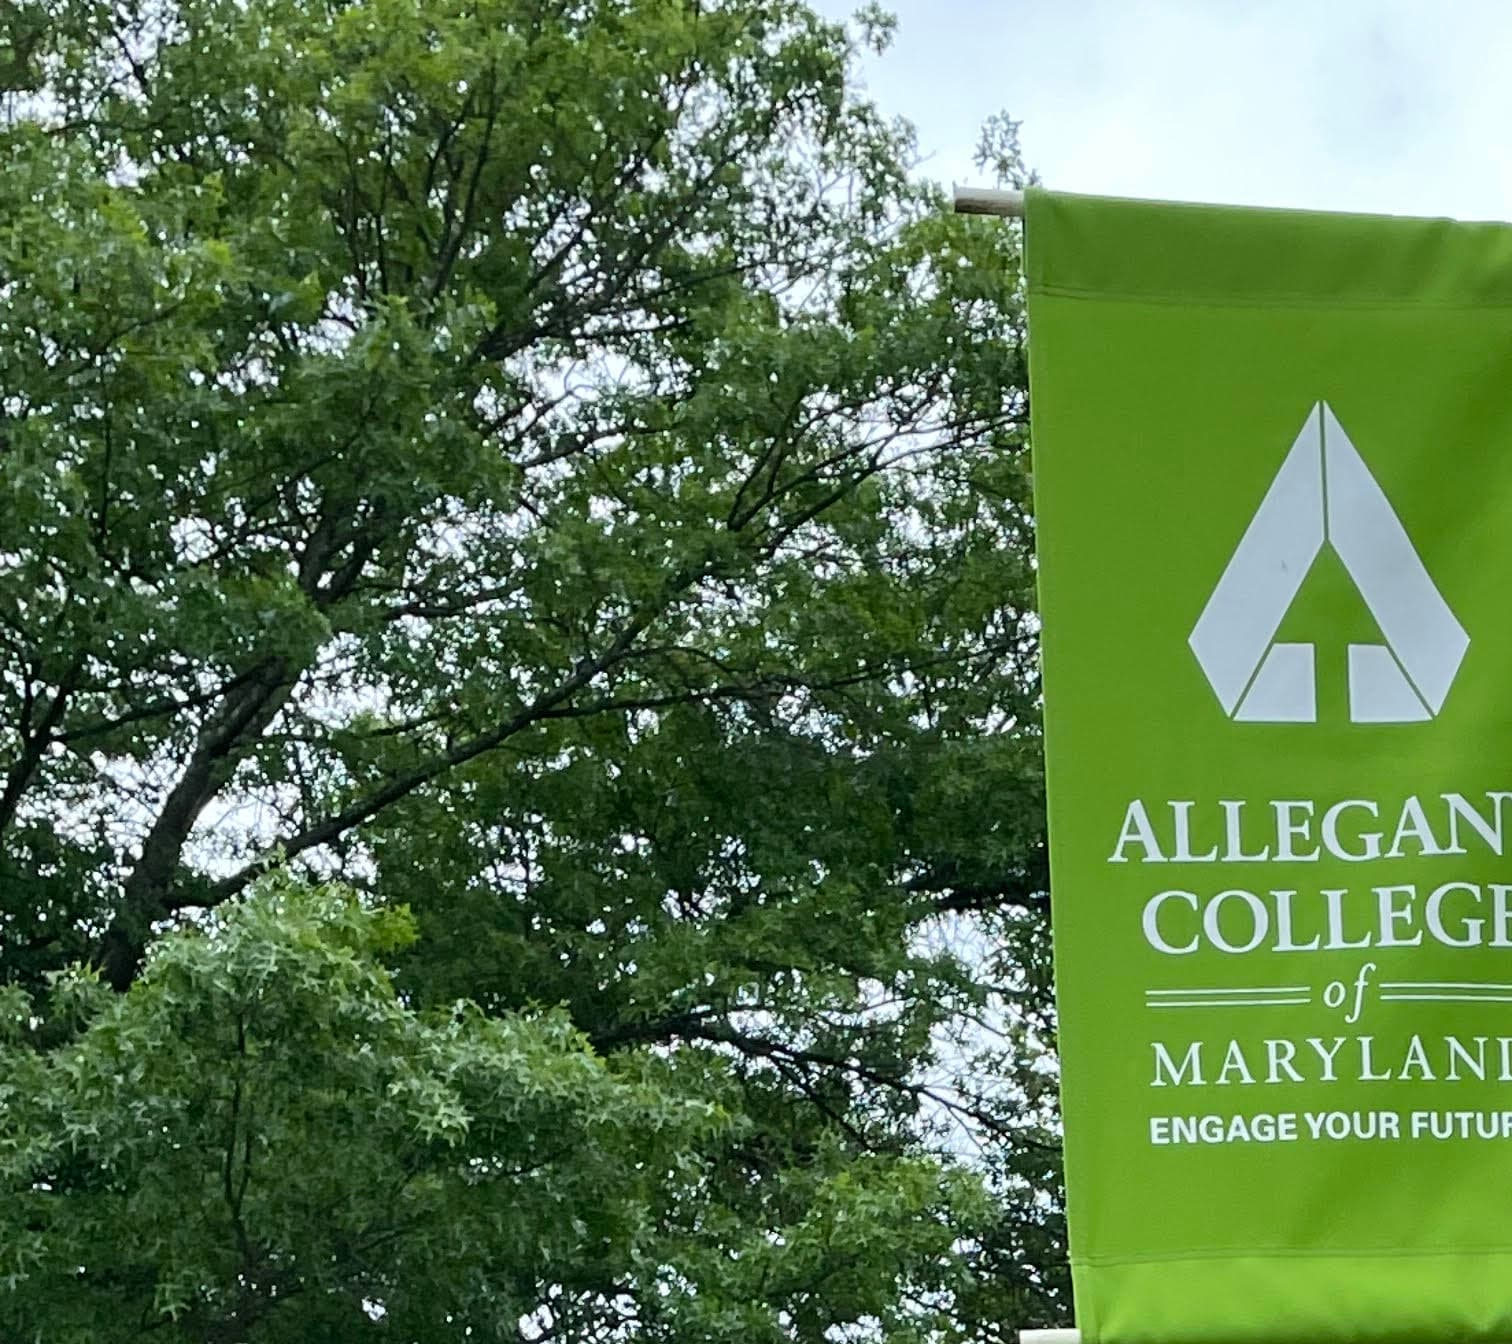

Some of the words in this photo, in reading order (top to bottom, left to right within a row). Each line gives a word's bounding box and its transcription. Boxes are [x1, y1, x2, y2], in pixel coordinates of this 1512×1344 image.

[1323, 963, 1377, 1023] of
[1150, 1113, 1298, 1145] ENGAGE
[1304, 1111, 1400, 1140] YOUR
